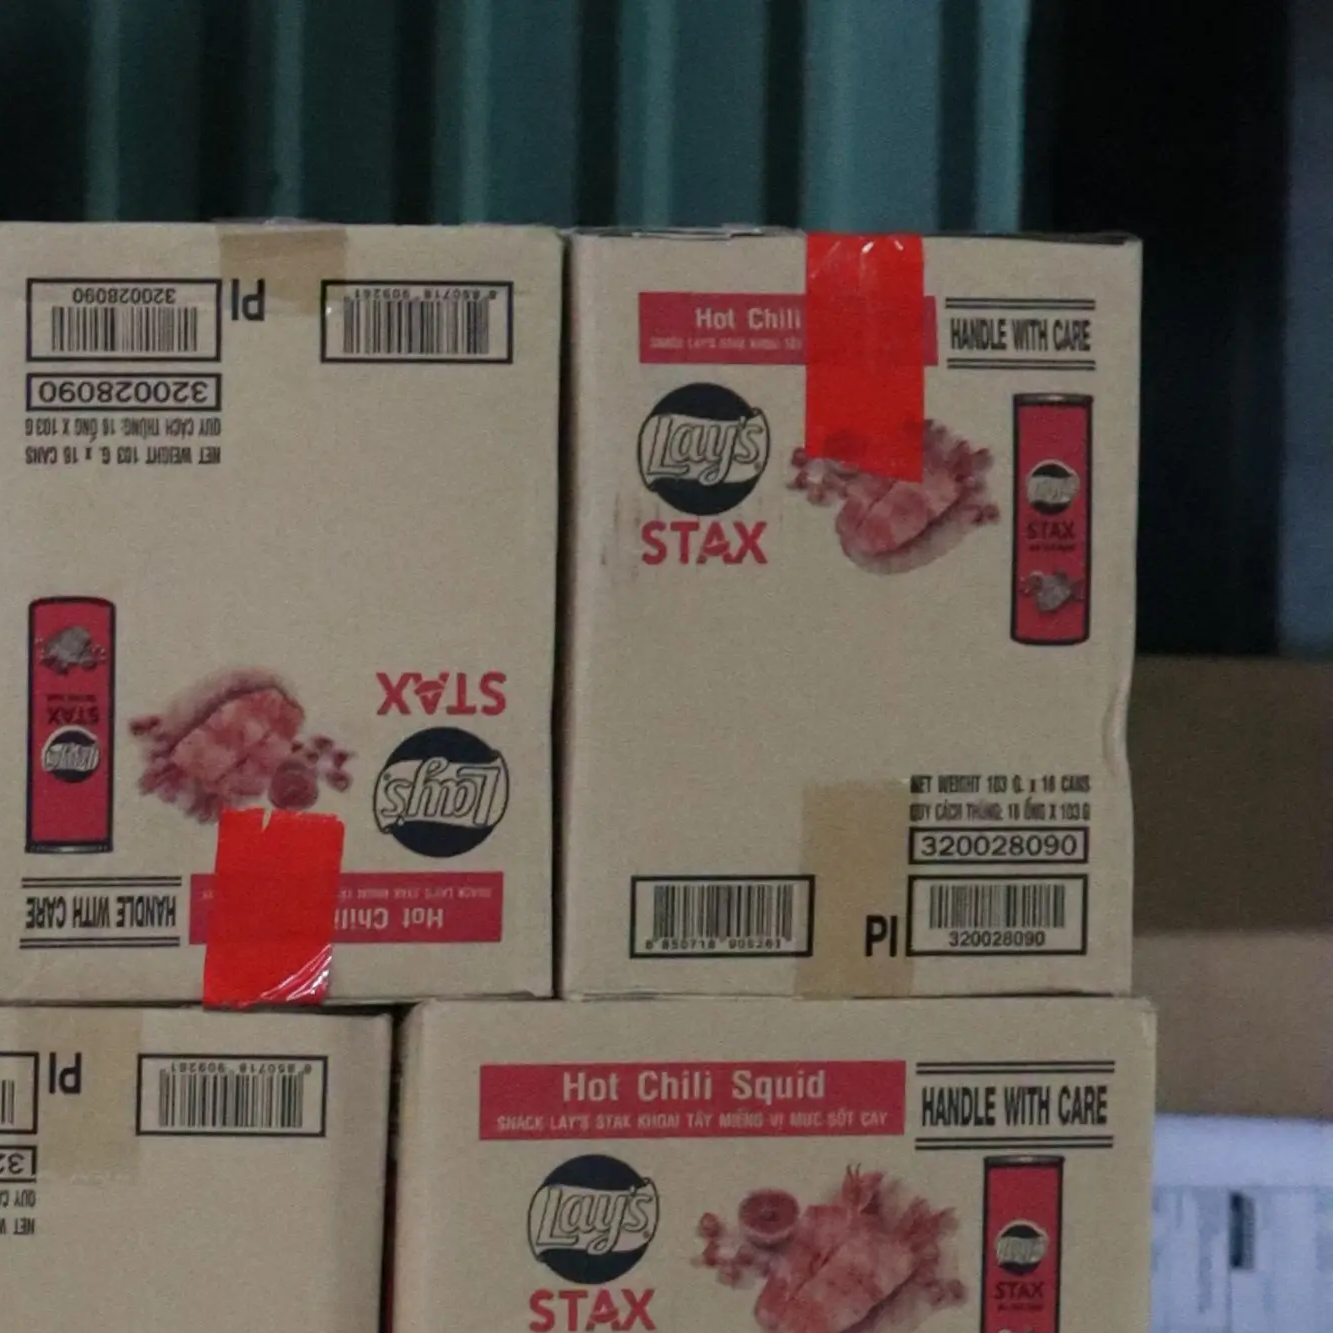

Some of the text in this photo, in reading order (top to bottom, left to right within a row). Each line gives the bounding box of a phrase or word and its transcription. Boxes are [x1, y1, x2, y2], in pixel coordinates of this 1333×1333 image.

[39, 381, 207, 403] 320028090
[642, 520, 765, 564] STAX
[377, 670, 505, 715] STAX
[922, 834, 1077, 856] 320028090
[564, 1070, 824, 1105] Hot Chili Squid
[922, 1086, 1106, 1126] HANDLE WITH CARE
[530, 1288, 653, 1332] STAX
